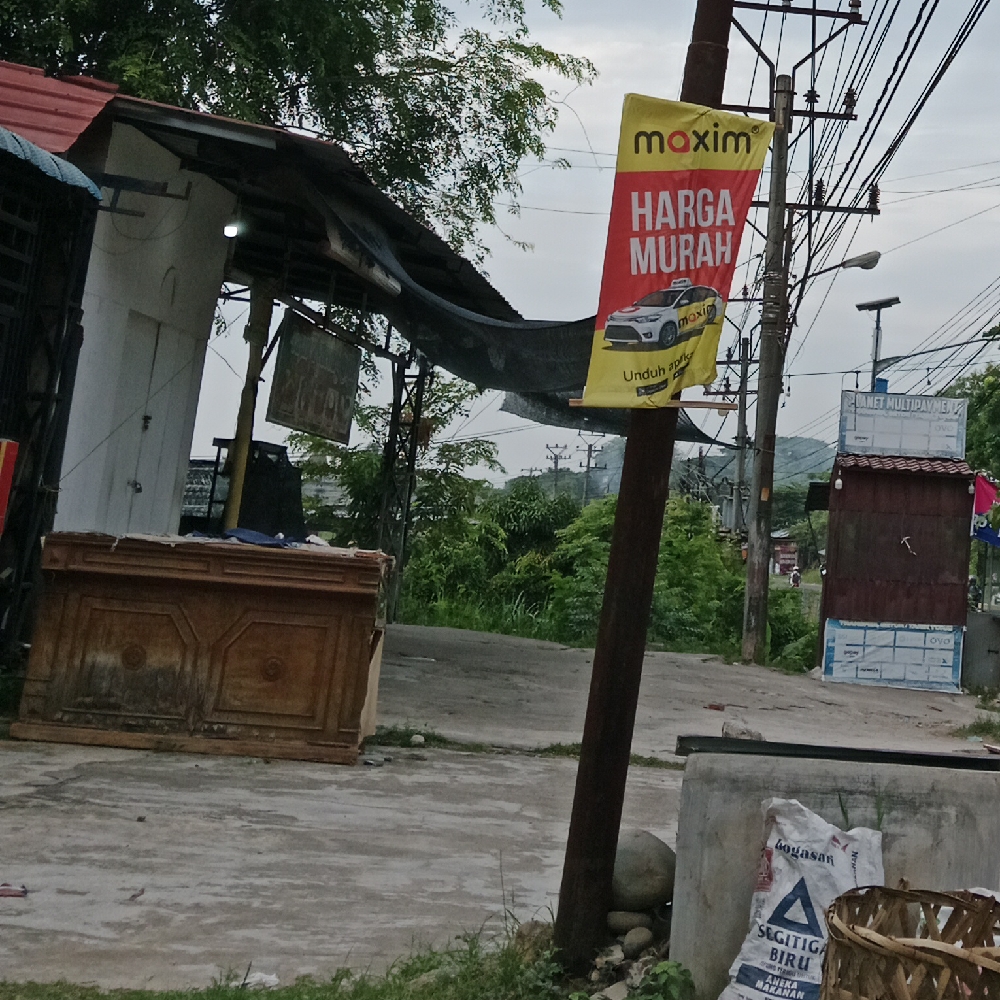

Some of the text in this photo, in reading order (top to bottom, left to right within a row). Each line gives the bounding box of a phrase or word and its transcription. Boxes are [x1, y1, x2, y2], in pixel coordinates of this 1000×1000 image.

[634, 122, 751, 154] maxim
[631, 188, 736, 232] HARGA
[629, 231, 733, 276] MURAH
[623, 365, 666, 382] Unduh
[758, 924, 827, 956] SEGITIG
[769, 947, 811, 971] BIRU
[755, 979, 805, 1000] MAKANAN
[765, 974, 798, 989] ANEKA
